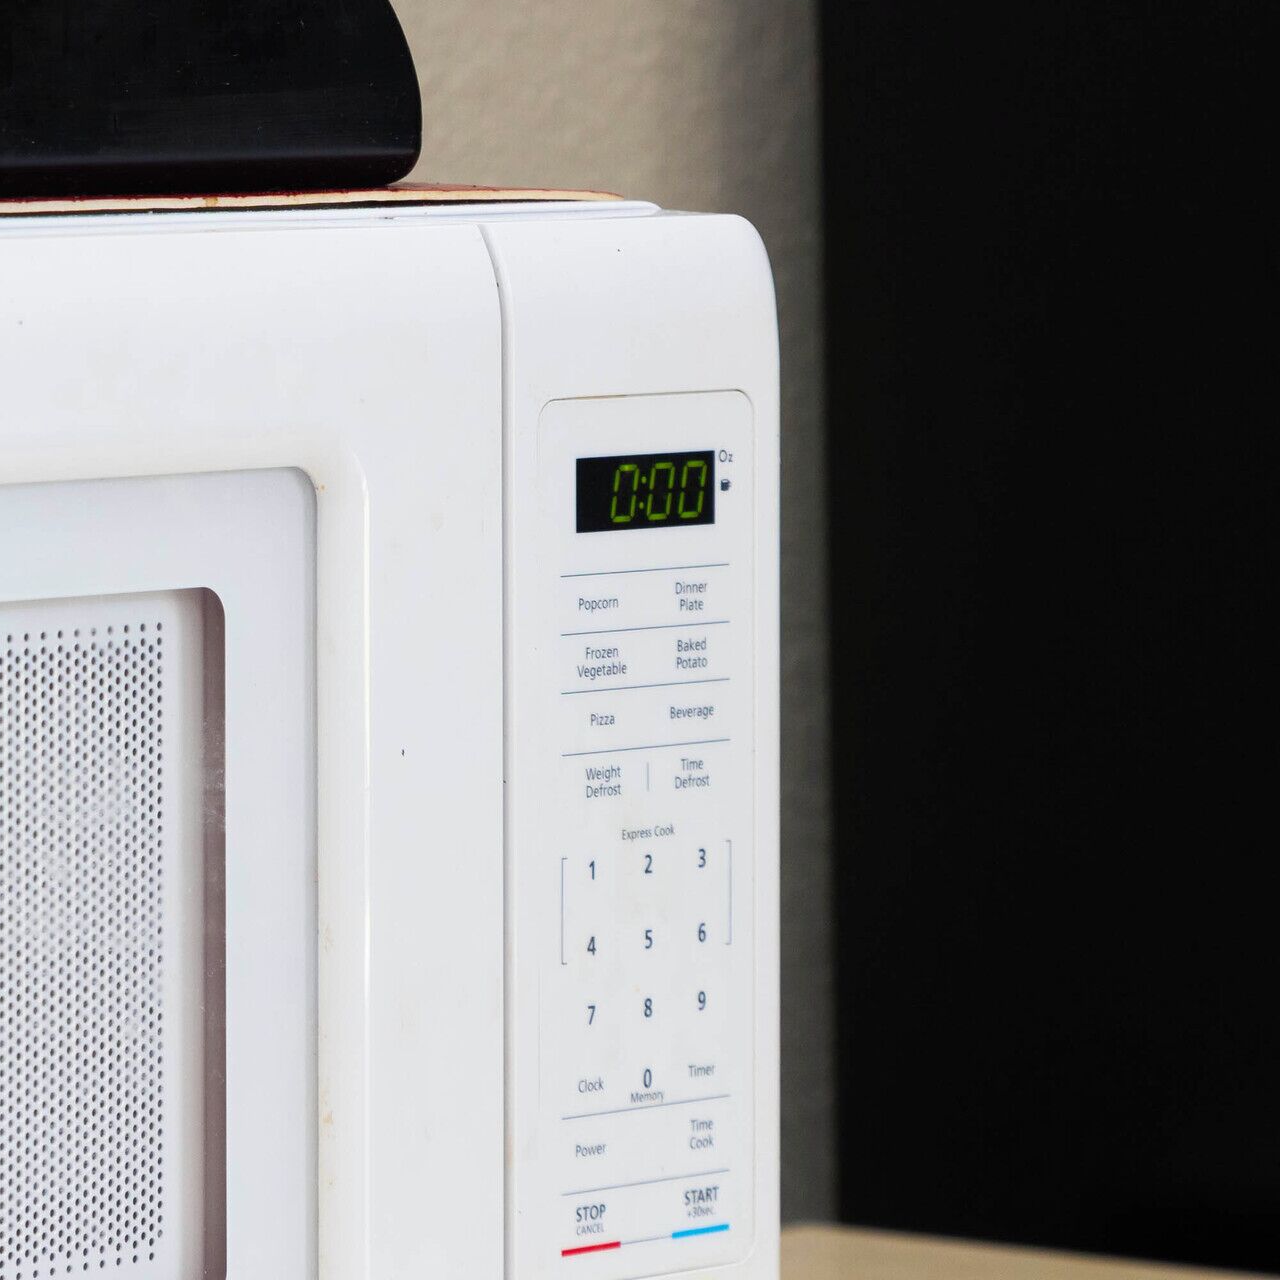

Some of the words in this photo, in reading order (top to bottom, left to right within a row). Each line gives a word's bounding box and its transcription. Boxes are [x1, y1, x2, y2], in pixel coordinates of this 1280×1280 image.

[718, 449, 733, 463] Oz
[611, 460, 707, 522] 0:00
[675, 581, 707, 595] Dinner
[577, 598, 619, 612] Popcorn
[680, 598, 704, 611] Plate
[677, 637, 706, 652] Baked
[585, 647, 620, 662] Frozen
[675, 657, 708, 669] Potato
[577, 663, 627, 680] Vegetable
[591, 713, 615, 727] Pizza
[670, 706, 714, 720] Beverage
[681, 758, 704, 771] Time
[585, 765, 621, 781] Weight
[675, 774, 709, 789] Defrost
[586, 782, 621, 798] Defrost
[622, 829, 652, 842] Express
[654, 824, 674, 837] Cook
[589, 860, 595, 880] 1
[644, 854, 653, 874] 2
[696, 848, 706, 868] 3
[587, 936, 597, 956] 4
[643, 929, 653, 950] 5
[697, 922, 707, 943] 6
[587, 1003, 596, 1025] 7
[643, 997, 653, 1018] 8
[697, 990, 706, 1011] 9
[688, 1064, 714, 1077] Timer
[578, 1077, 604, 1093] Clock
[643, 1068, 652, 1089] 0
[631, 1092, 665, 1104] Memory
[691, 1119, 713, 1132] Time
[690, 1135, 714, 1150] Cook
[576, 1144, 606, 1157] Power
[684, 1186, 719, 1206] START
[576, 1204, 607, 1222] STOP
[576, 1224, 604, 1236] CANCEL
